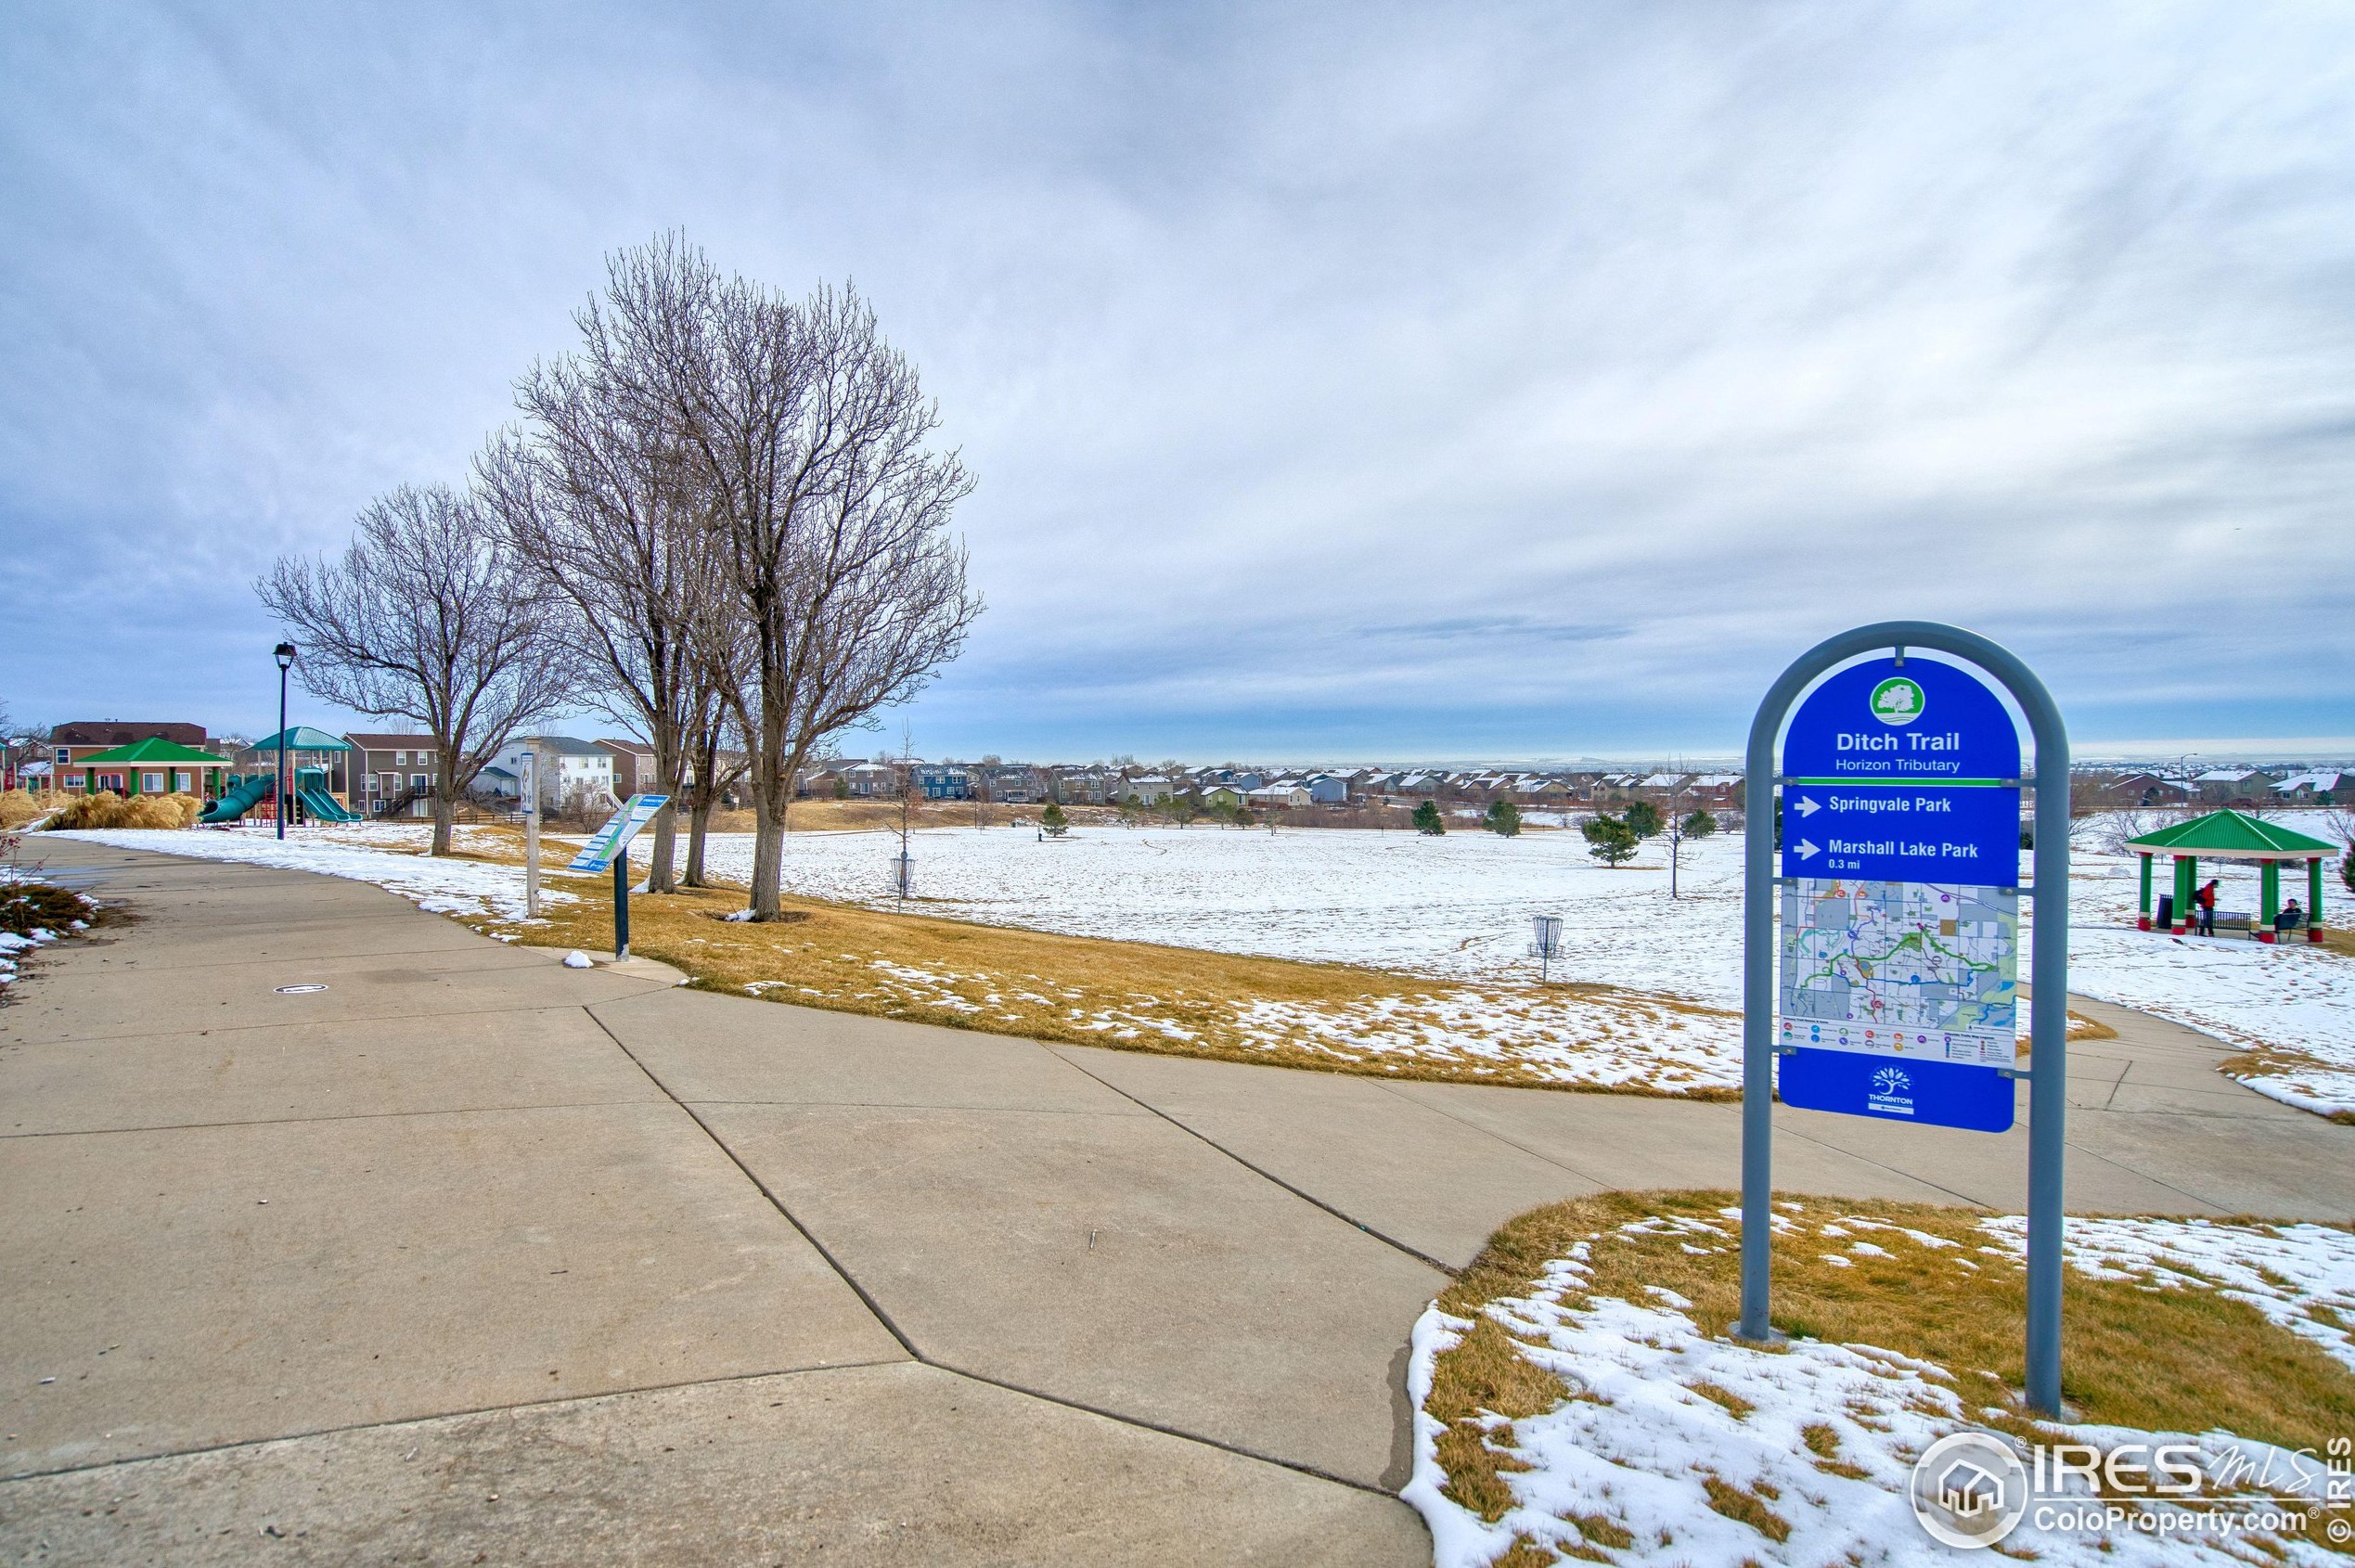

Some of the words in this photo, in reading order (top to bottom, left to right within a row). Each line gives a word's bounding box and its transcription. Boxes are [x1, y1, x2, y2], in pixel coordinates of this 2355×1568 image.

[1836, 732, 1898, 752] Ditch
[1906, 732, 1960, 752] Trail
[1835, 758, 1891, 771] Horizon
[1895, 758, 1961, 775] Tributary
[1829, 795, 1911, 814] Springvale
[1915, 797, 1952, 813] Park
[1828, 839, 1895, 855] Marshall
[1899, 842, 1937, 857] Lake
[1941, 842, 1978, 858] Park
[1828, 858, 1845, 869] 0.3
[1847, 859, 1860, 870] mi
[1868, 1093, 1913, 1105] THORNTON
